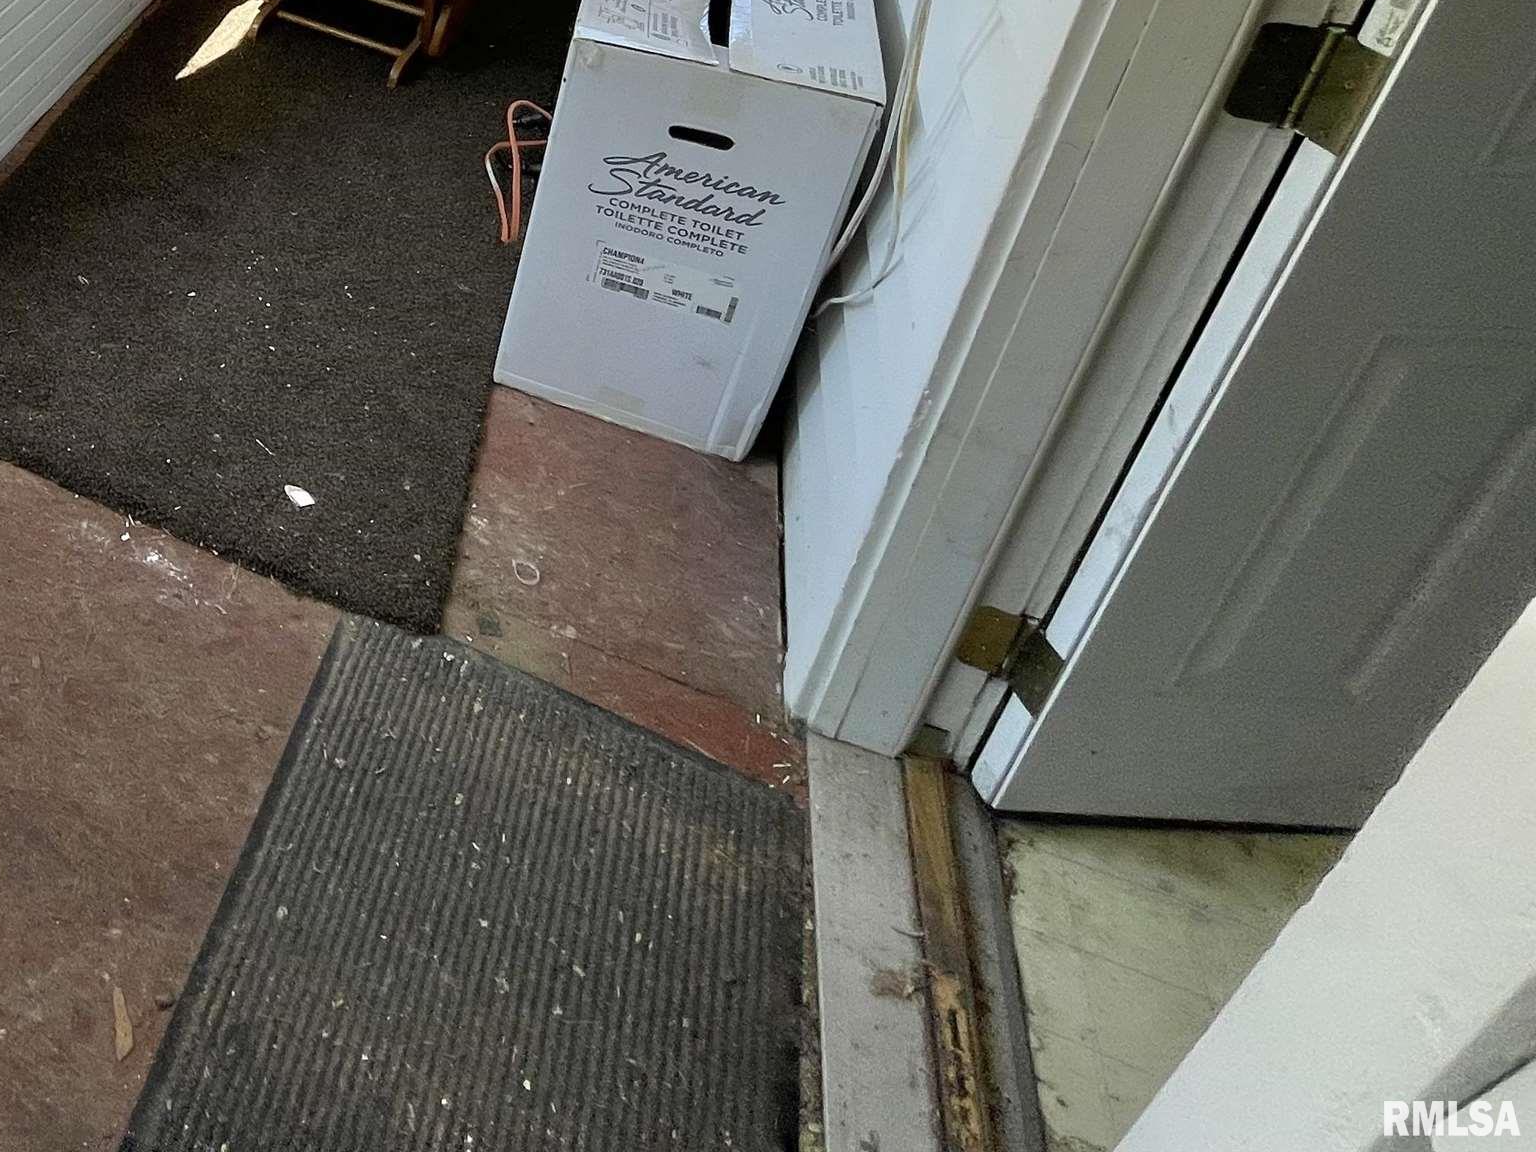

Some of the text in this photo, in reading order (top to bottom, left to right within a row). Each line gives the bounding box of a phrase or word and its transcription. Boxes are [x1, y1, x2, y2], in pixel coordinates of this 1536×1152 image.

[588, 168, 766, 226] Standard
[603, 152, 786, 205] American
[595, 205, 749, 254] TOILETTE COMPLETE
[609, 198, 745, 241] COMPLETE TOILET
[615, 221, 724, 257] INODORO COMPLETO
[671, 289, 693, 301] WHITE
